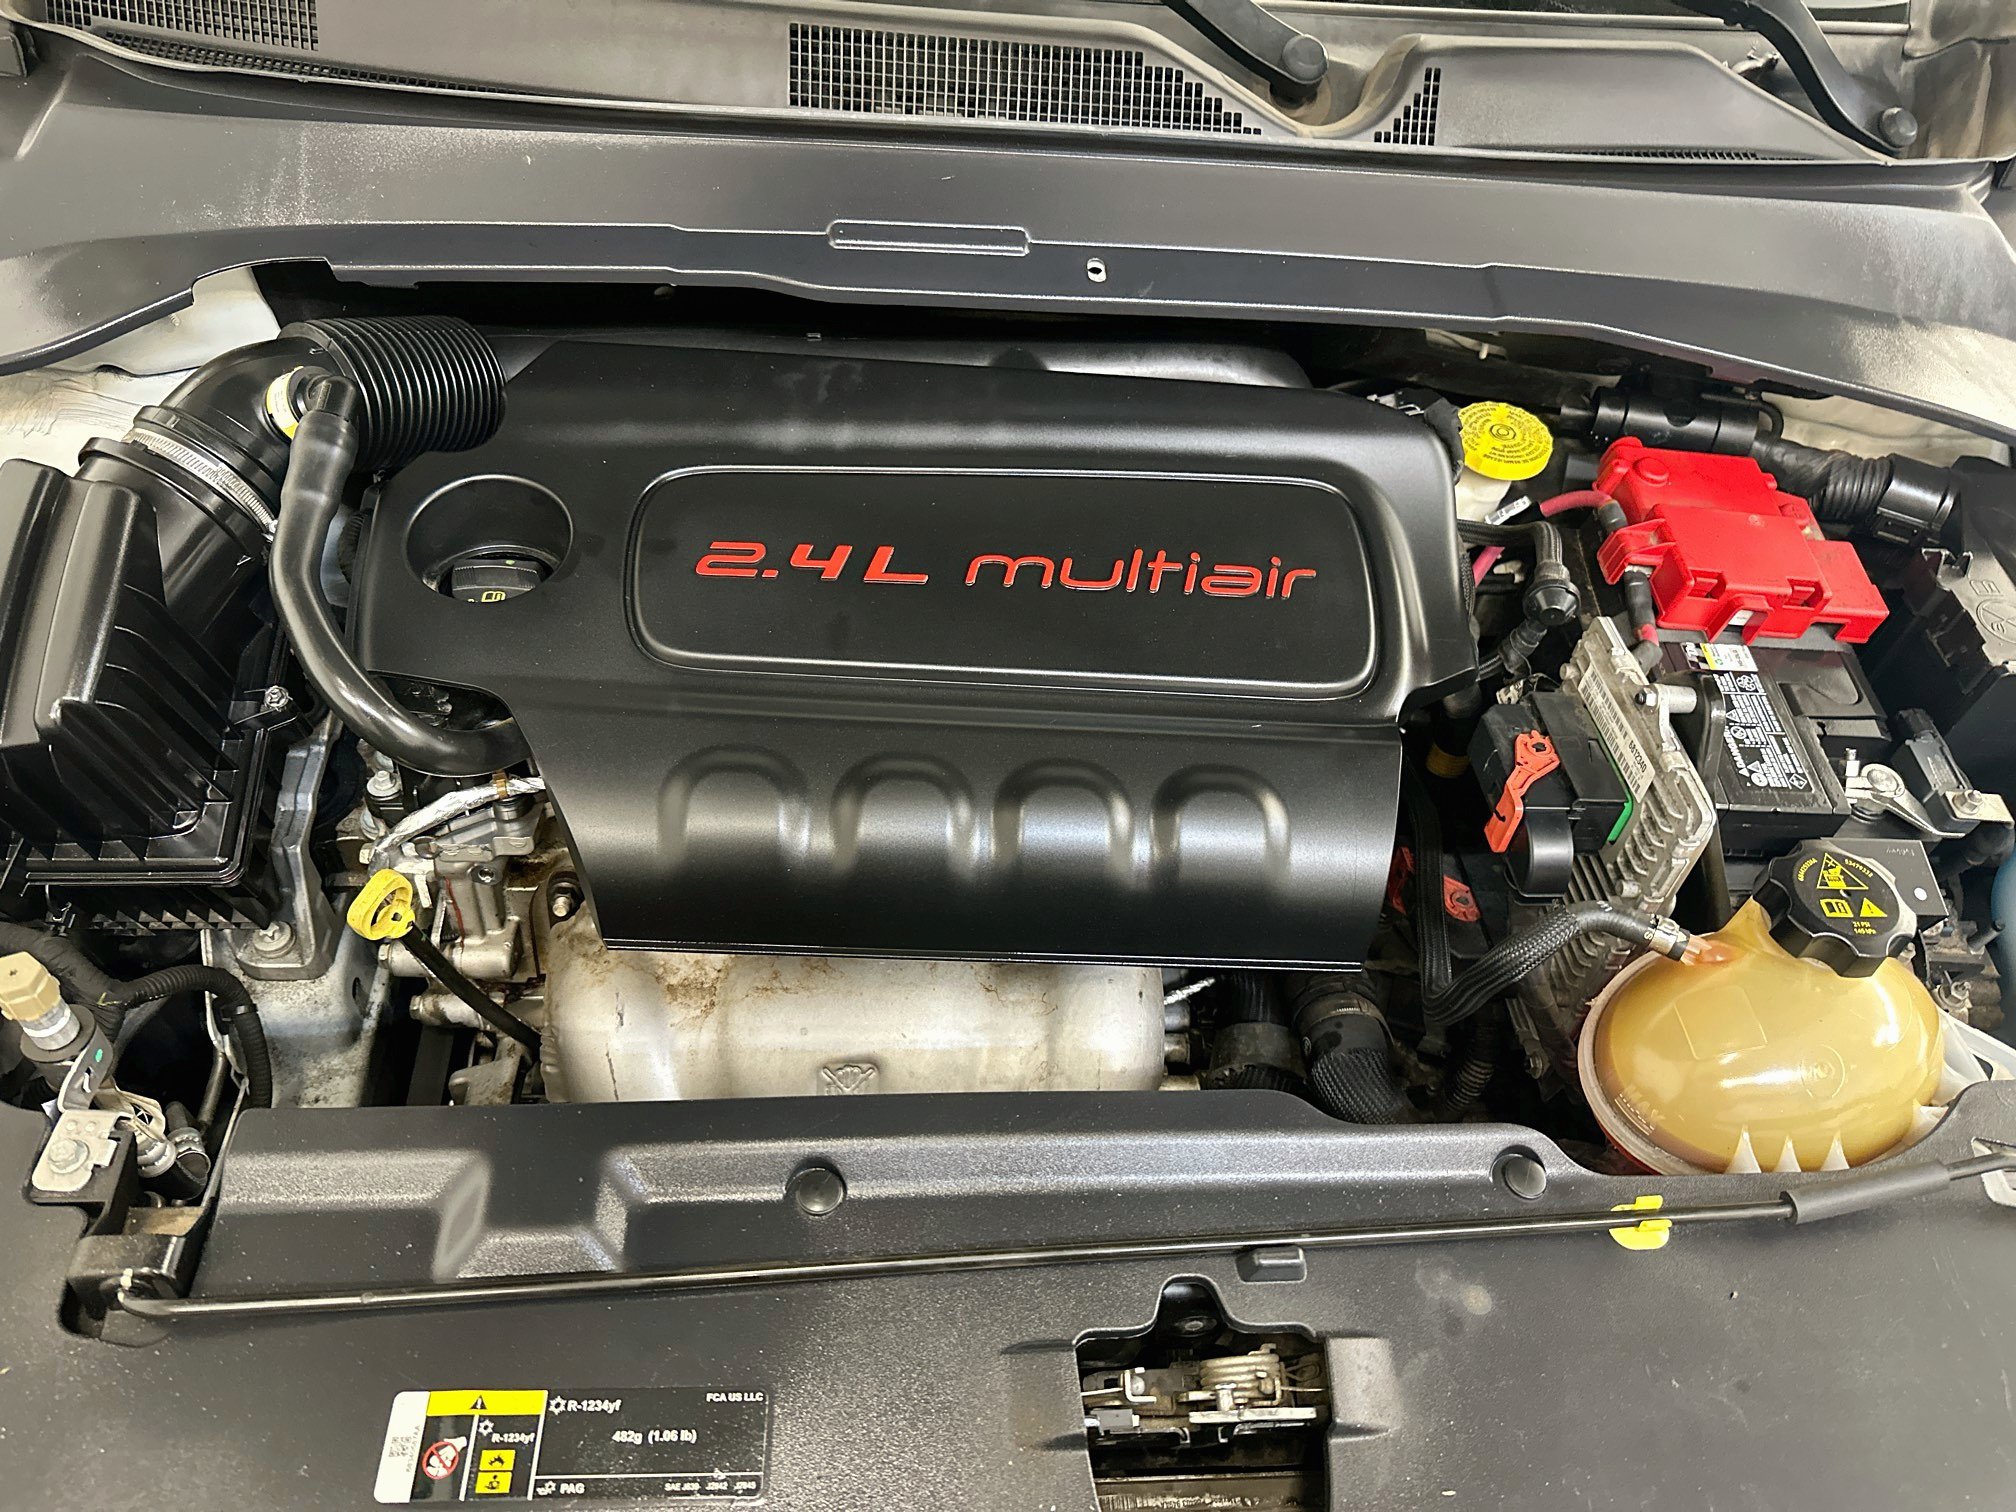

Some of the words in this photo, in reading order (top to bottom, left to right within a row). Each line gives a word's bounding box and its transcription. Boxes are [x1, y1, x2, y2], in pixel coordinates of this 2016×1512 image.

[964, 548, 1318, 600] multiair
[706, 1392, 727, 1402] FCA
[728, 1392, 742, 1402] US
[743, 1391, 764, 1402] LLC
[567, 1399, 622, 1414] R-1234yf
[491, 1432, 535, 1444] R-1234yf
[612, 1429, 643, 1445] 482g
[647, 1429, 679, 1445] (1.06
[679, 1429, 697, 1444] lb)
[559, 1483, 585, 1494] PAG
[664, 1482, 682, 1491] SAE
